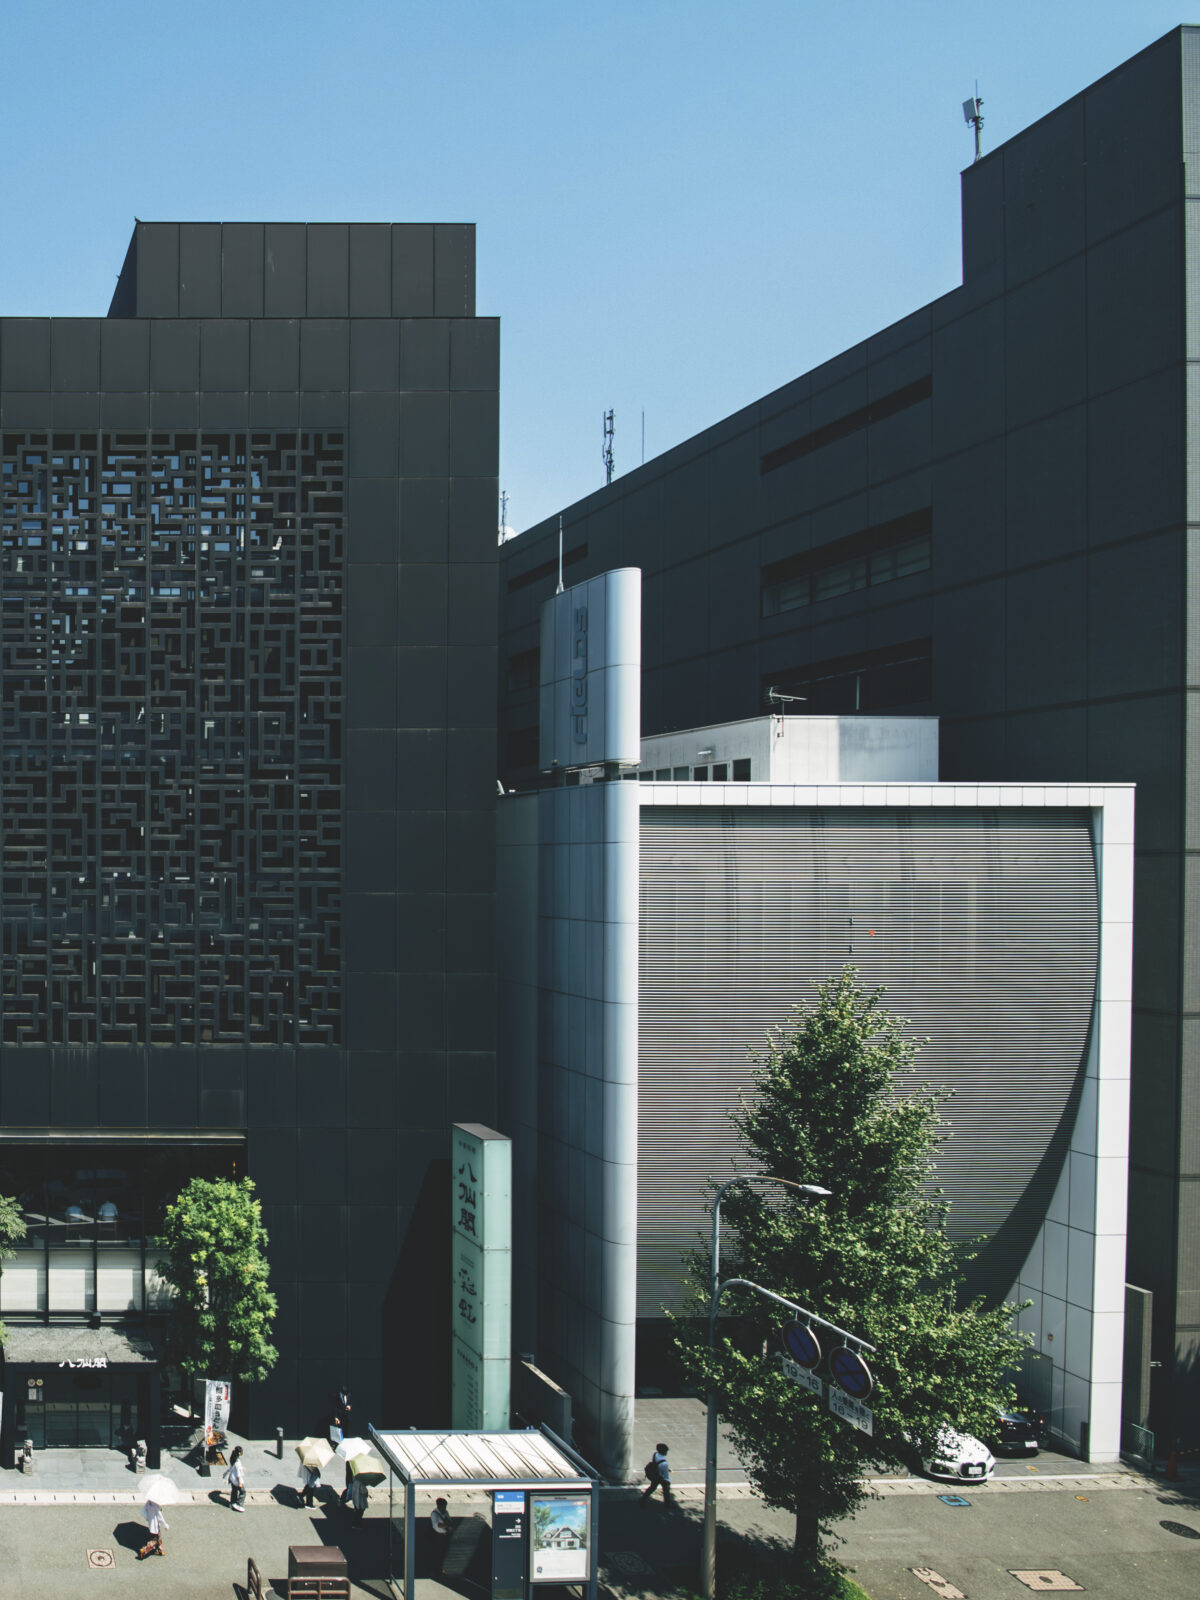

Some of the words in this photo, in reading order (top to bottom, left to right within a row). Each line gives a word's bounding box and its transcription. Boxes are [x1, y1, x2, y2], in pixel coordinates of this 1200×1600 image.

[458, 1162, 477, 1237] 八仙閣
[58, 1357, 107, 1369] 八仙閣
